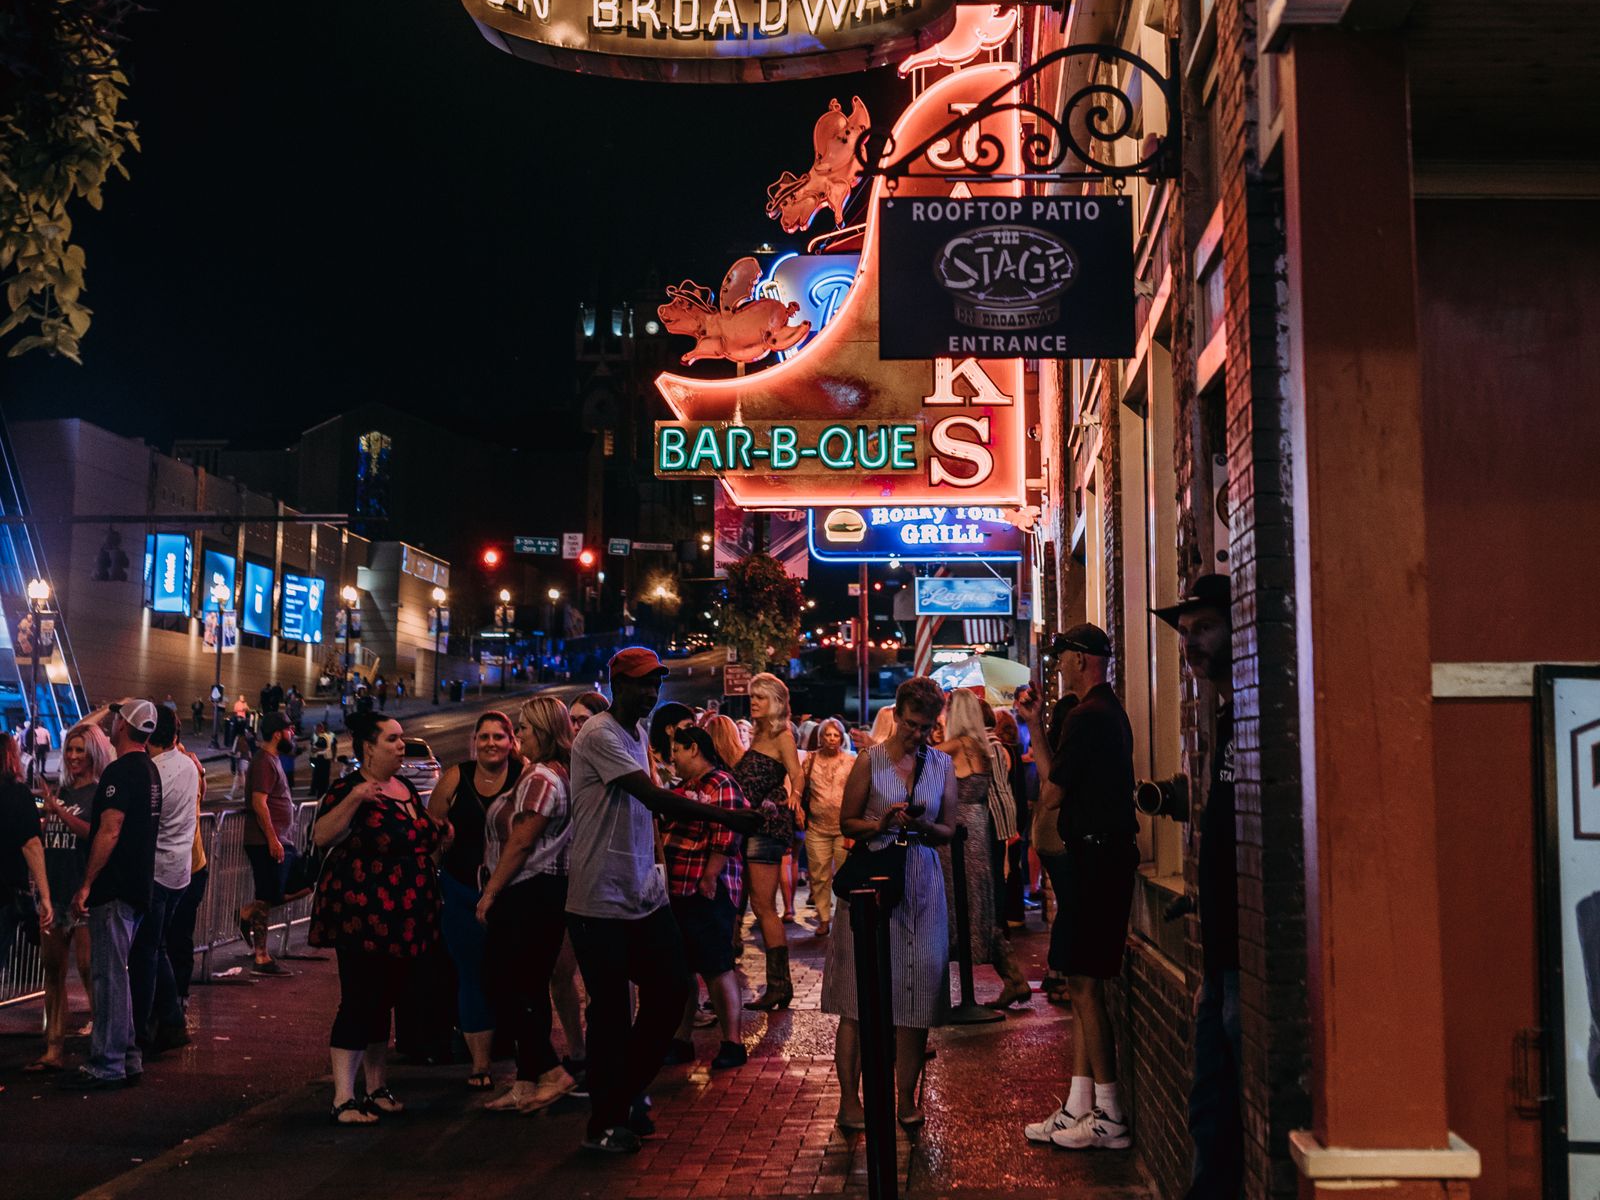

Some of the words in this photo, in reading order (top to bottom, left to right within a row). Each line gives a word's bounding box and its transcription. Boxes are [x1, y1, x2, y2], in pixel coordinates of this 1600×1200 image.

[912, 201, 1023, 222] ROOFTOP
[1032, 200, 1100, 221] PATIO
[993, 231, 1020, 244] THE
[943, 237, 1072, 289] STAGE
[923, 102, 1014, 488] JKS
[982, 308, 1056, 327] BROADWAY
[949, 335, 1067, 352] ENTRANCE
[659, 425, 918, 471] BAR-B-QUE
[900, 523, 985, 544] GRILL
